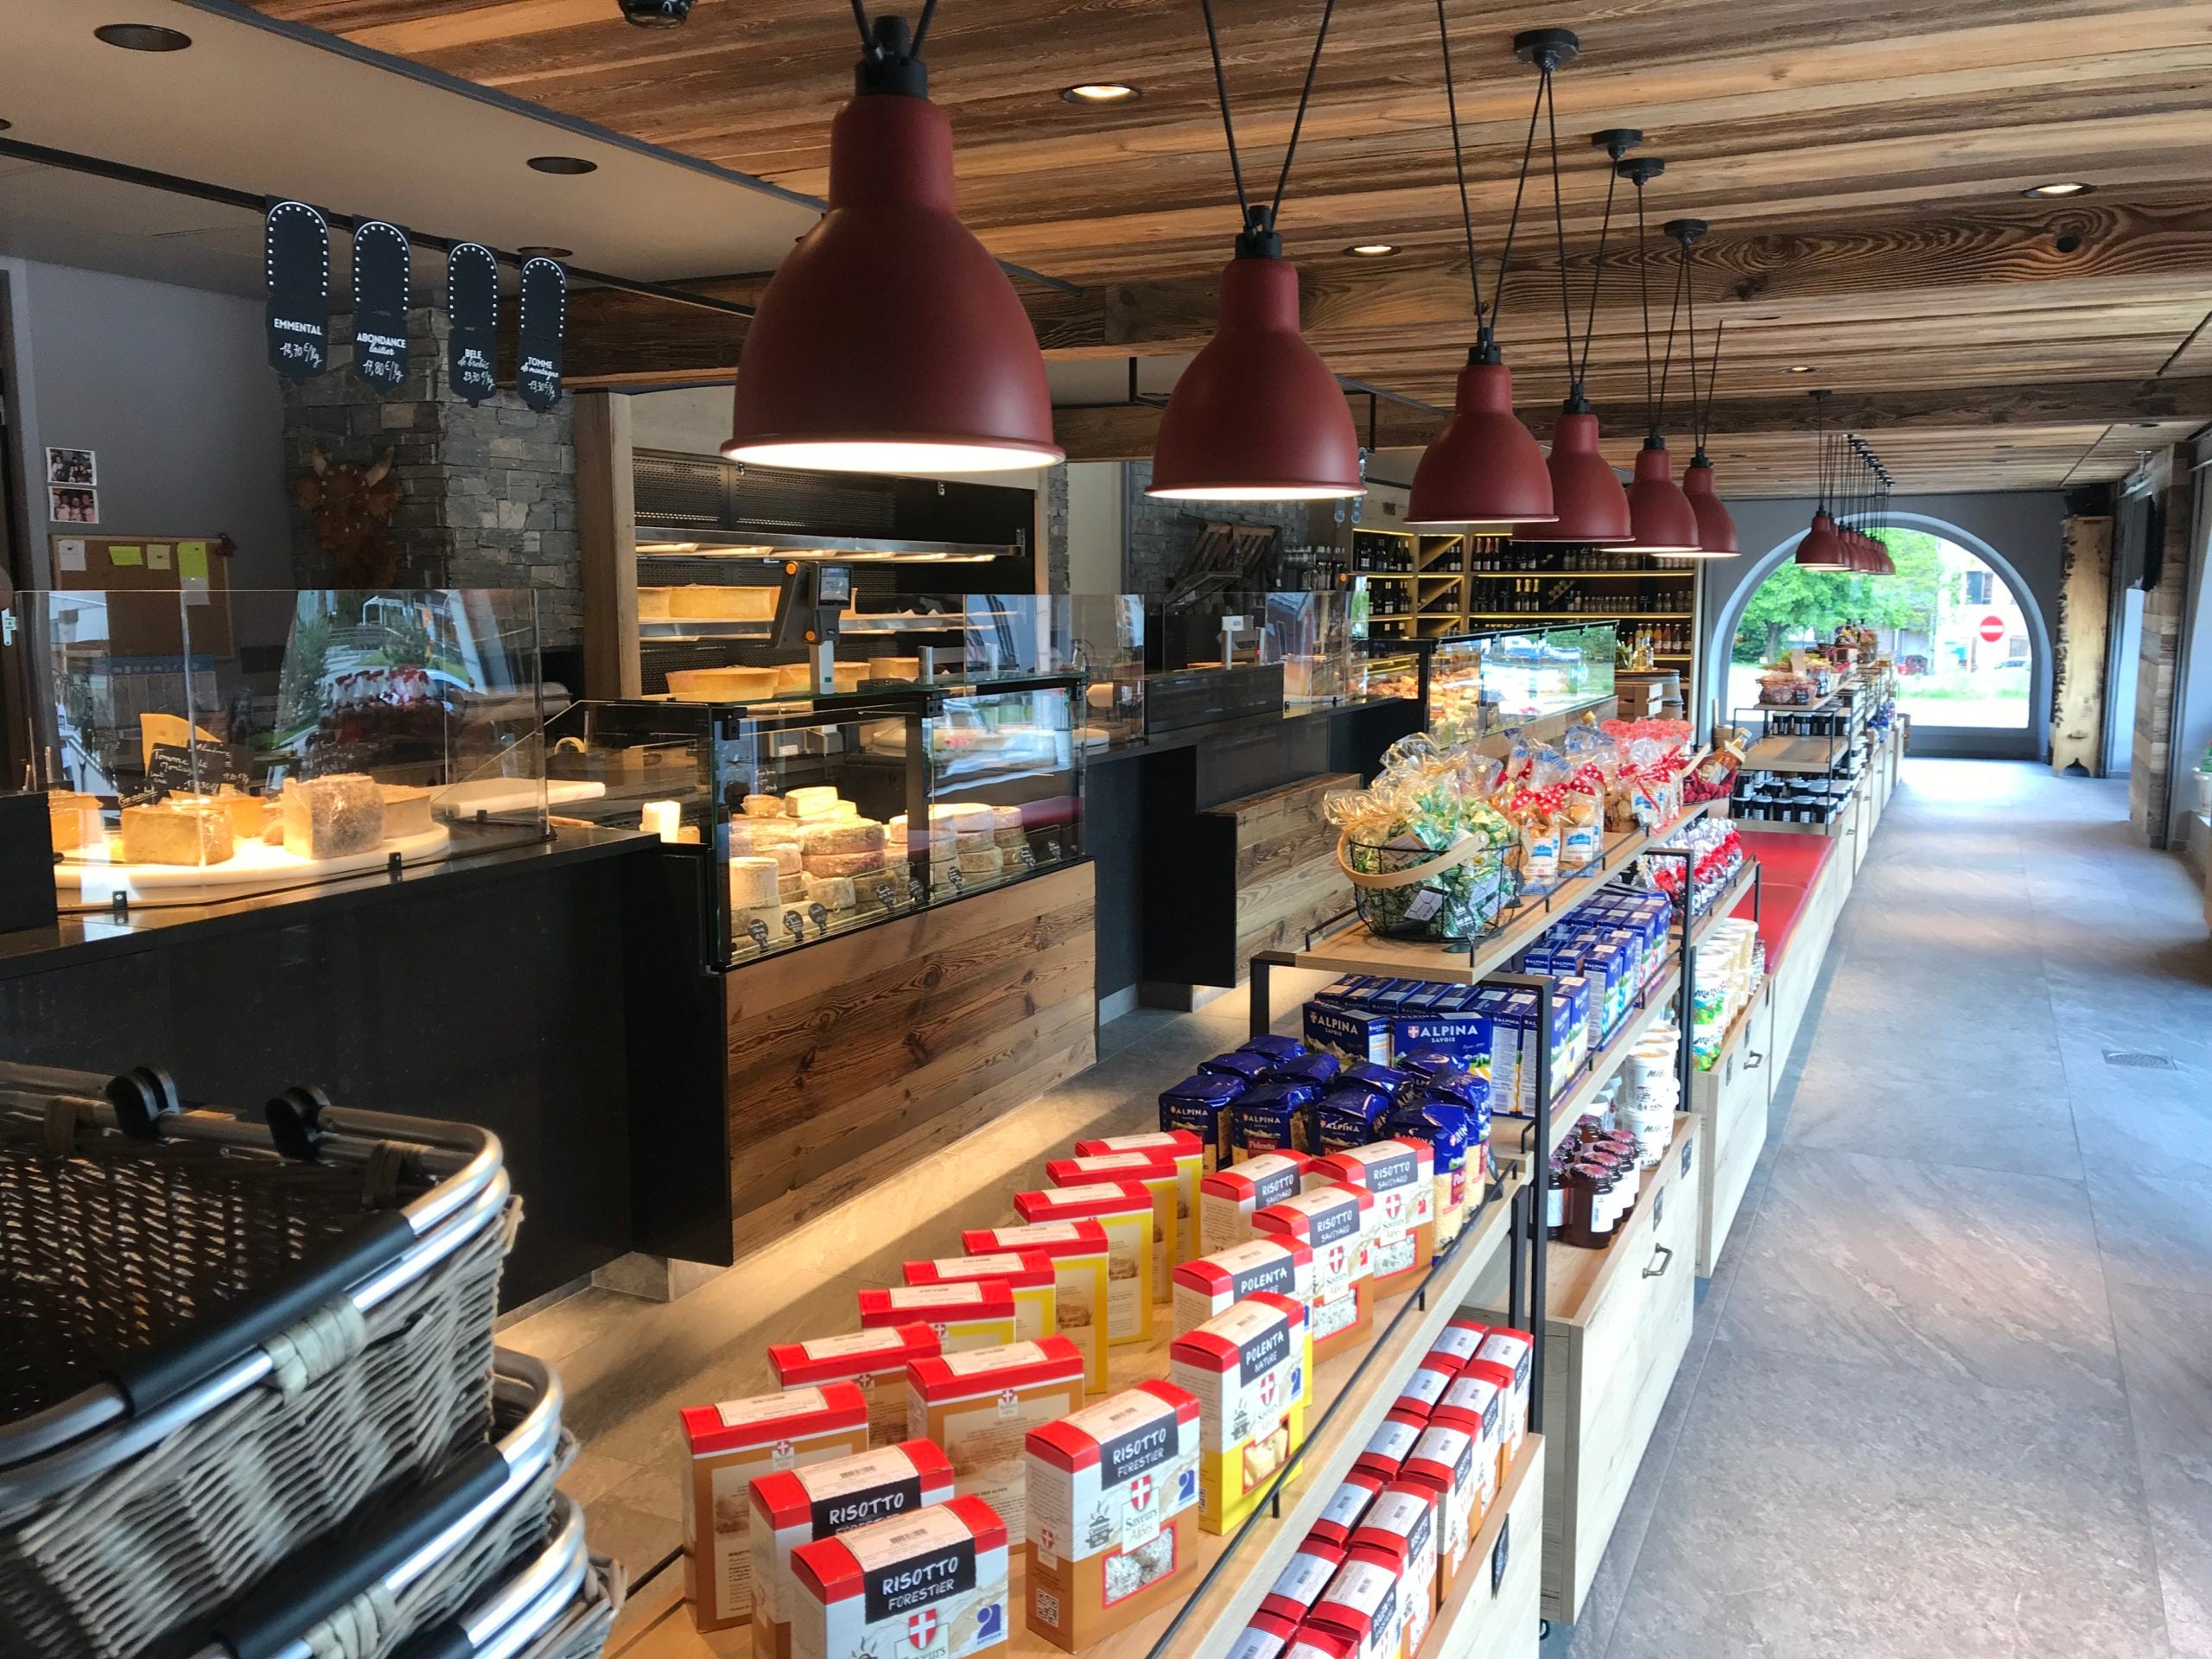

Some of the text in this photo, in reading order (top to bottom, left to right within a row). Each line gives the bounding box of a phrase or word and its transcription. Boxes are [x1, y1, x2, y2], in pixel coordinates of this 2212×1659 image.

[274, 318, 322, 335] EMMENTAL
[356, 333, 407, 348] ABONDANCE
[527, 356, 553, 370] TOMME
[160, 761, 205, 777] Montage
[1318, 1014, 1358, 1036] ALPINA
[1325, 1027, 1343, 1037] SAVOIE
[1420, 1024, 1478, 1037] ALPINA
[1176, 1106, 1208, 1116] ALPINA
[1249, 1115, 1281, 1124] ALPINA
[1325, 1122, 1360, 1134] ALPINA
[1248, 1139, 1276, 1151] Polenta
[1373, 1160, 1411, 1181] RISOTTO
[1262, 1173, 1294, 1197] RISOTTO
[1376, 1174, 1408, 1190] SAVOYARD
[1317, 1210, 1353, 1233] RISOTTO
[1320, 1224, 1351, 1243] SAVOYARD
[1241, 1266, 1287, 1294] POLENTA
[1245, 1331, 1285, 1366] POLENTA
[1254, 1351, 1278, 1374] NATURE
[1112, 1427, 1166, 1465] RISOTTO
[1117, 1447, 1165, 1478] FORESTIER
[829, 1492, 905, 1525] RISOTTO
[1125, 1509, 1158, 1532] Saveurs
[882, 1556, 959, 1596] RISOTTO
[887, 1579, 955, 1611] FORESTIER
